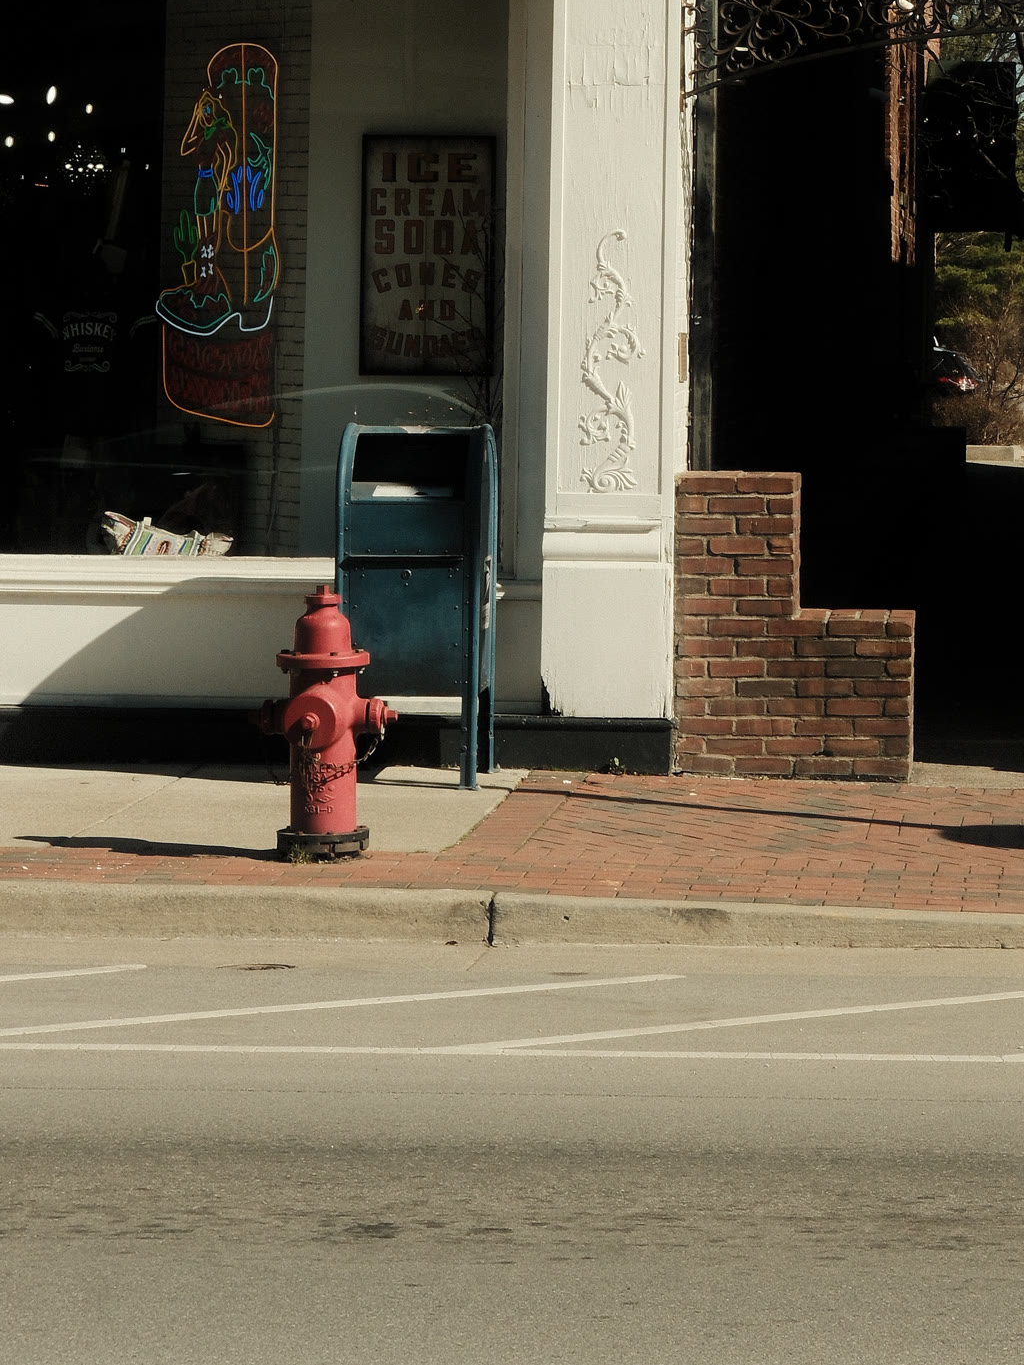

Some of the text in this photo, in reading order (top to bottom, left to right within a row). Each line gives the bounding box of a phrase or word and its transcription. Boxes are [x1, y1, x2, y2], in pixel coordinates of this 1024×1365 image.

[381, 152, 478, 183] ICE
[370, 188, 487, 217] CREAM
[374, 219, 482, 255] SODA
[371, 262, 482, 294] CONES
[398, 299, 457, 321] AND
